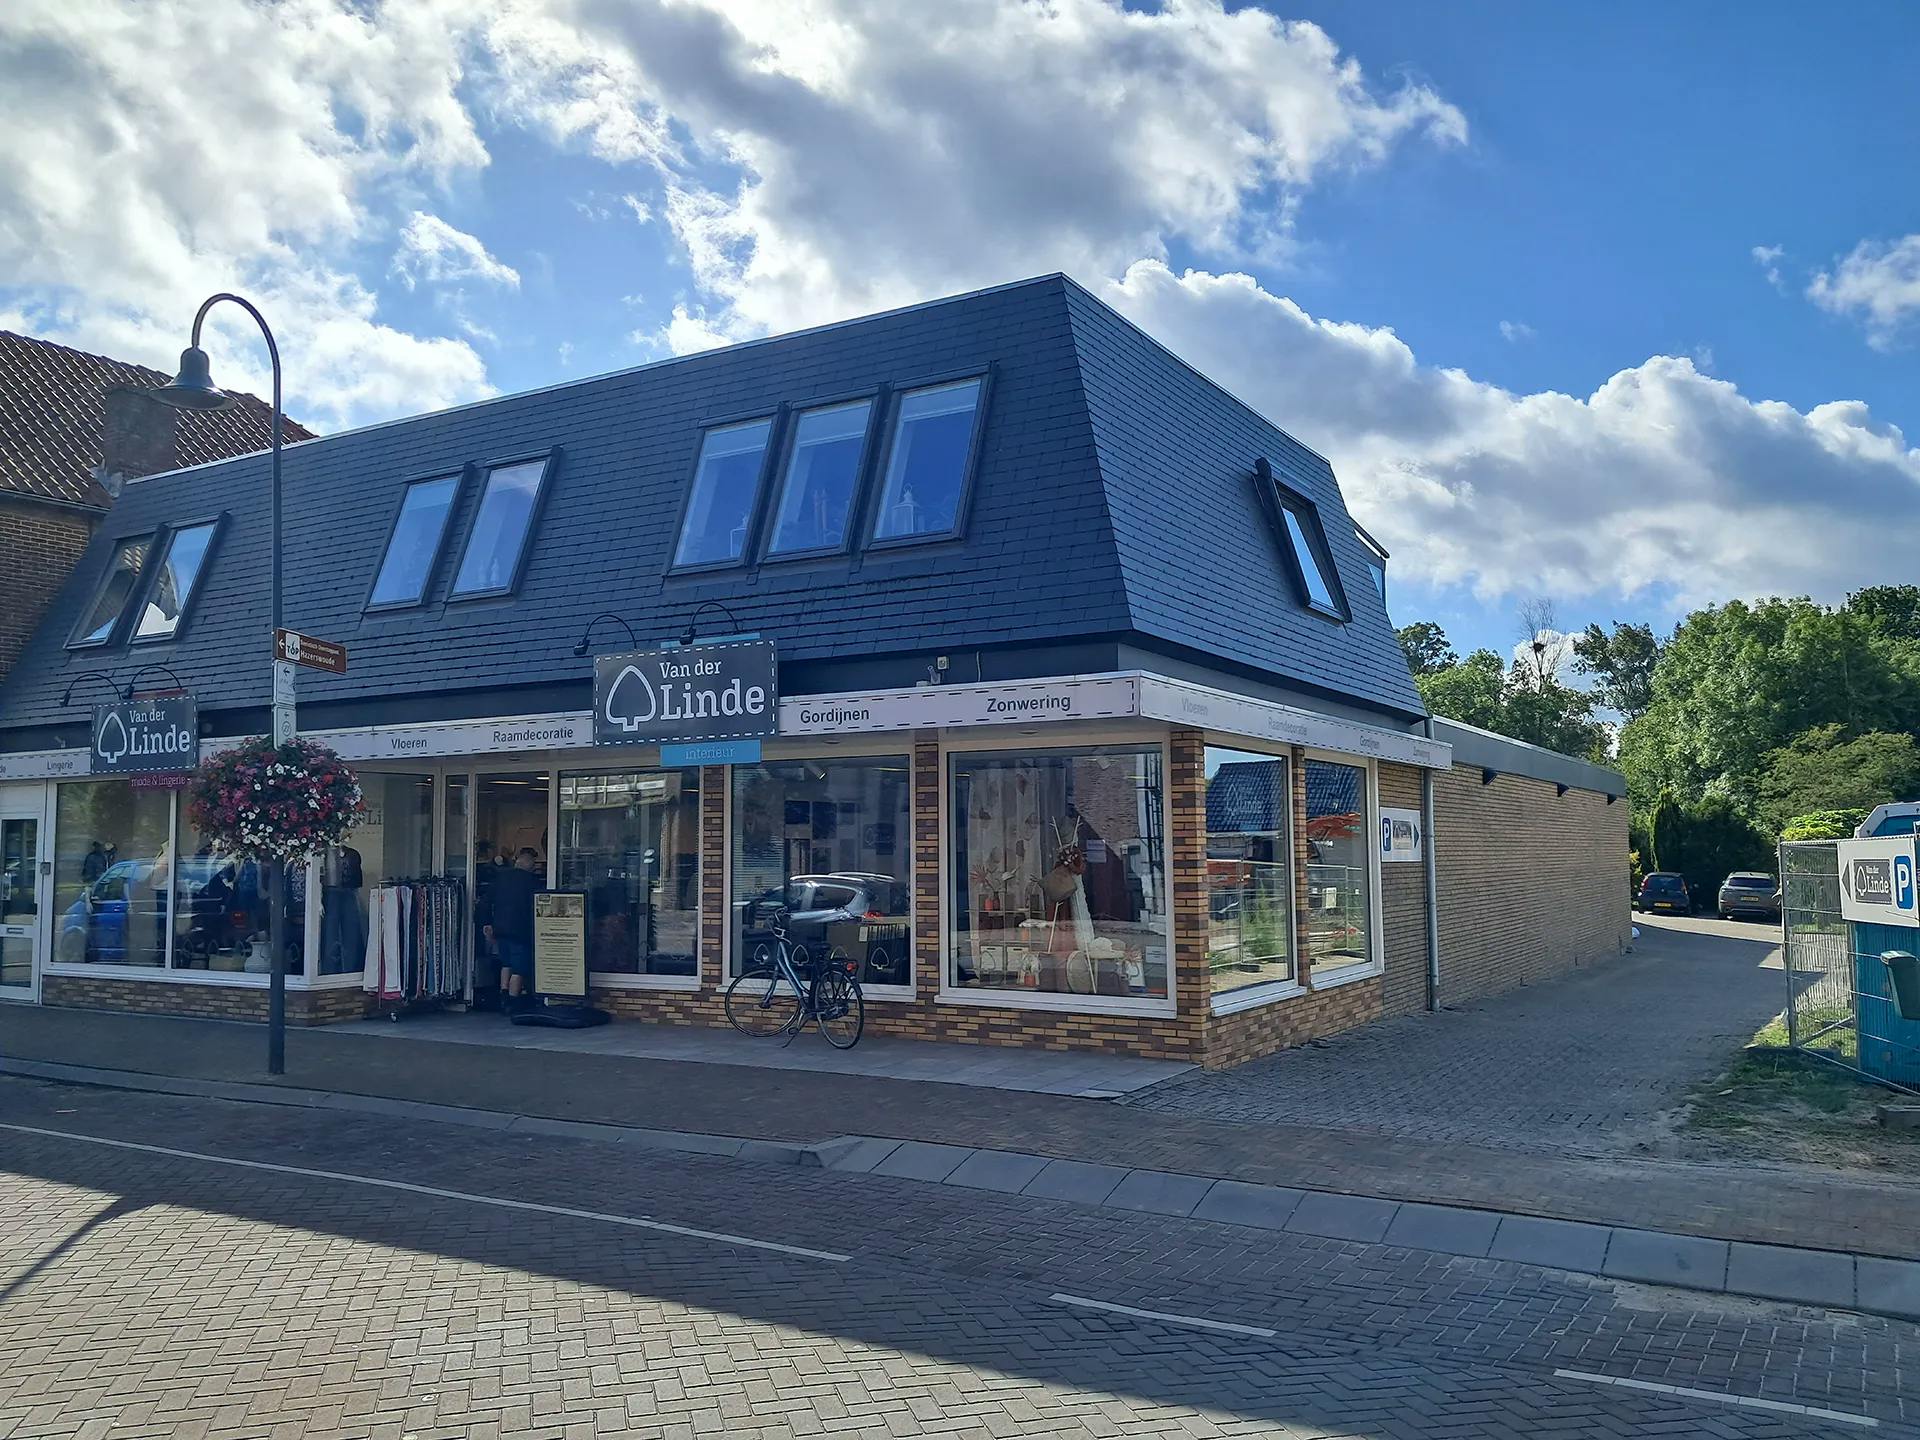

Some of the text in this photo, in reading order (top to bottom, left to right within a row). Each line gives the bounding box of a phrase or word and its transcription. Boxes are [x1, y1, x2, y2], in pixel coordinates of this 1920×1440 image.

[659, 659, 722, 679] Van der
[660, 678, 765, 721] Linde
[986, 694, 1071, 713] Zonwering
[129, 708, 166, 723] Van der
[800, 707, 870, 725] Gordijnen
[129, 724, 190, 756] Linde
[493, 726, 574, 743] Raamdecoratie
[391, 738, 428, 750] Vloeren
[685, 746, 736, 760] interieur
[47, 759, 74, 772] Lingerie
[131, 774, 186, 787] mode & lingerie
[1383, 822, 1390, 848] P
[1866, 876, 1889, 894] Linde
[1897, 863, 1910, 902] P
